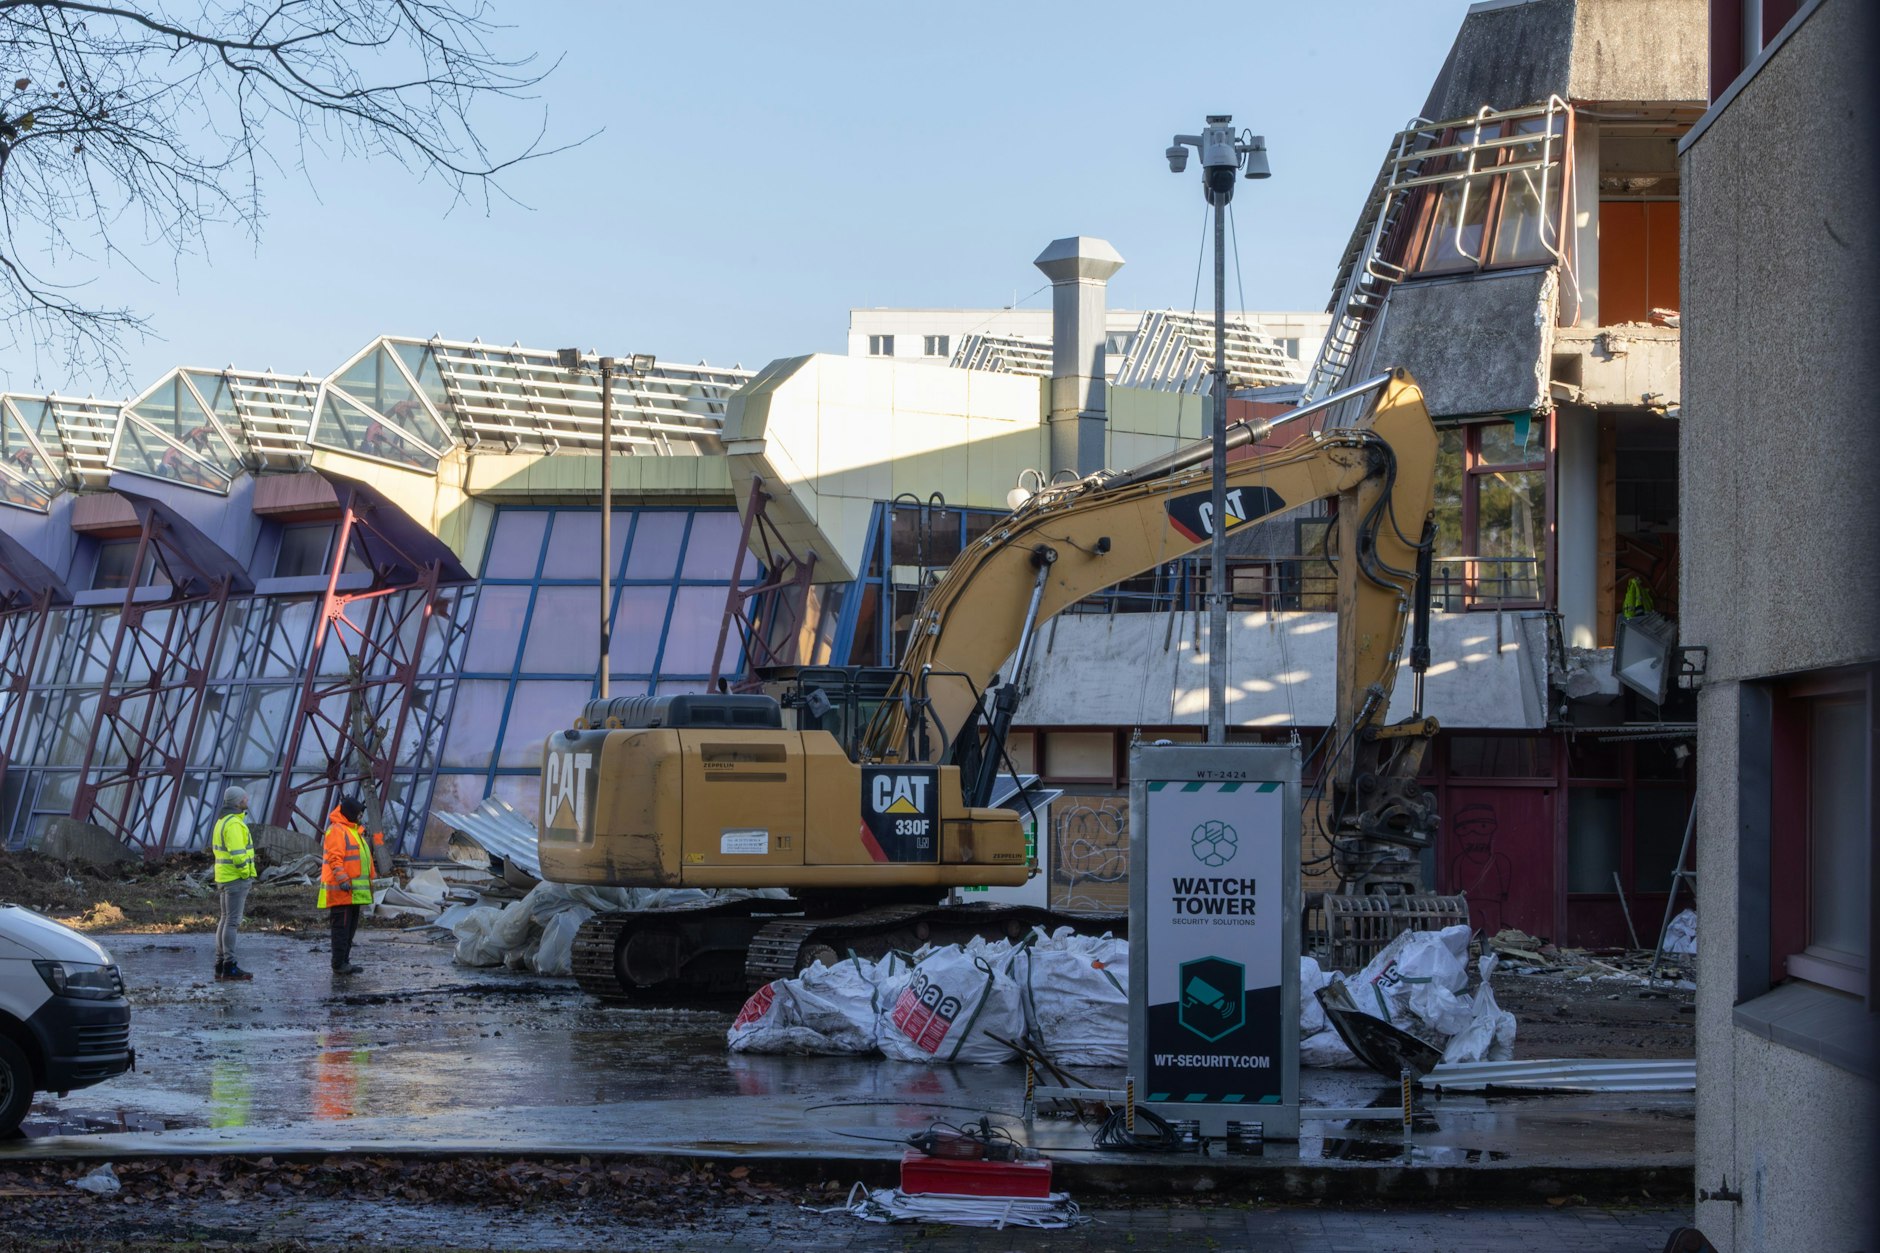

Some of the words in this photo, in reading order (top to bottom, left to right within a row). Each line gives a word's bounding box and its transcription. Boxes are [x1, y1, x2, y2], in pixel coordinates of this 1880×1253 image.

[1196, 770, 1247, 779] WT-2424
[544, 751, 593, 832] CAT
[872, 774, 930, 814] CAT
[895, 819, 930, 836] 330F
[1172, 877, 1256, 896] WATCH
[1172, 897, 1256, 915] TOWER
[1172, 918, 1209, 926] SECURITY
[1212, 918, 1256, 926] SOLUTIONS
[1153, 1053, 1271, 1069] WT-SECURITY.COM
